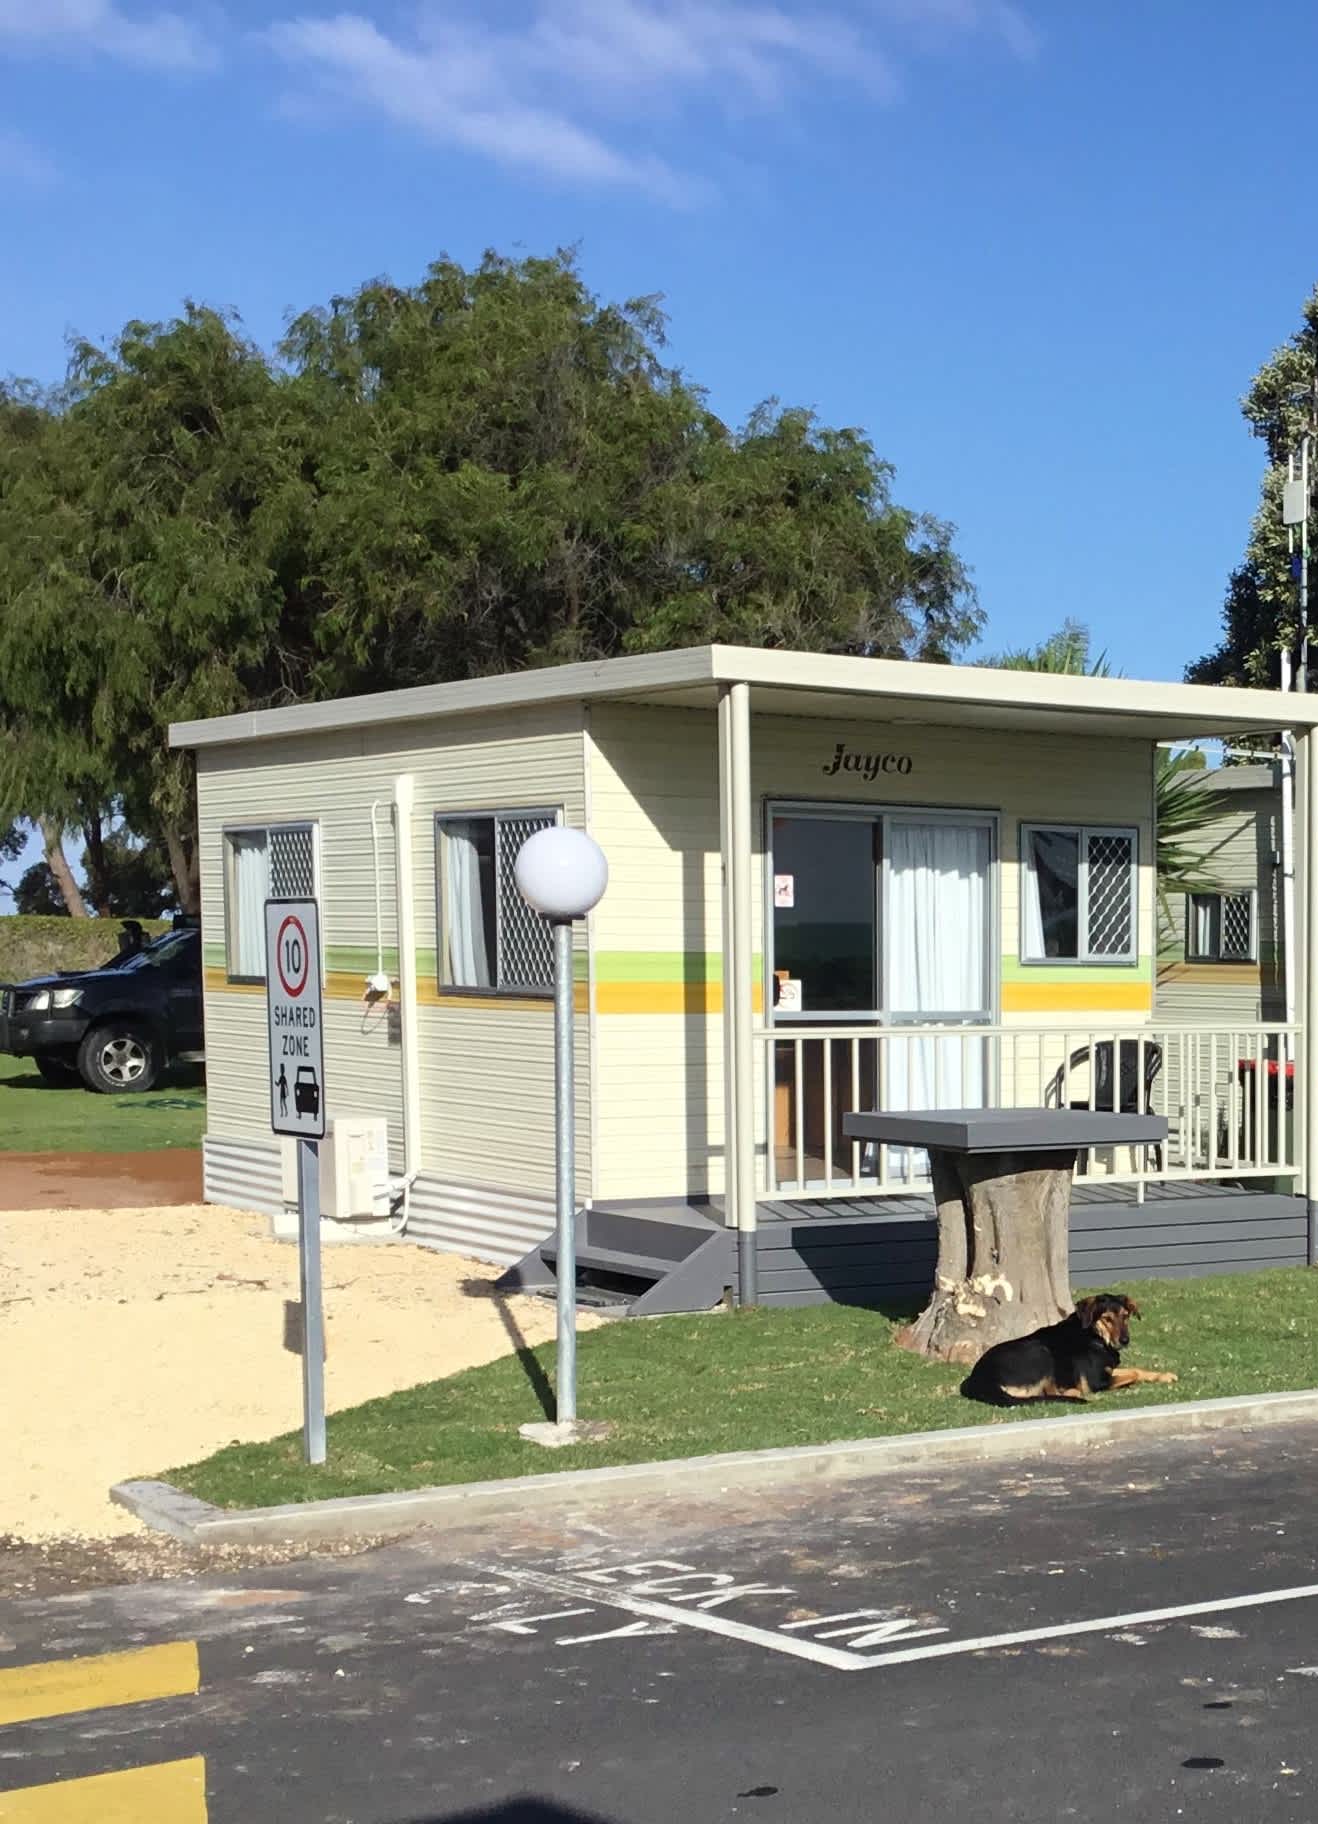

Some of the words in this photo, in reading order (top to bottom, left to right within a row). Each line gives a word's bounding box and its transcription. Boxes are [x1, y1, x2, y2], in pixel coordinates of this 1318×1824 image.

[822, 743, 913, 781] Jayco
[285, 939, 301, 974] 10
[274, 1005, 316, 1028] SHARED
[282, 1035, 310, 1057] ZONE
[540, 1552, 797, 1609] ECK
[778, 1609, 950, 1648] IN
